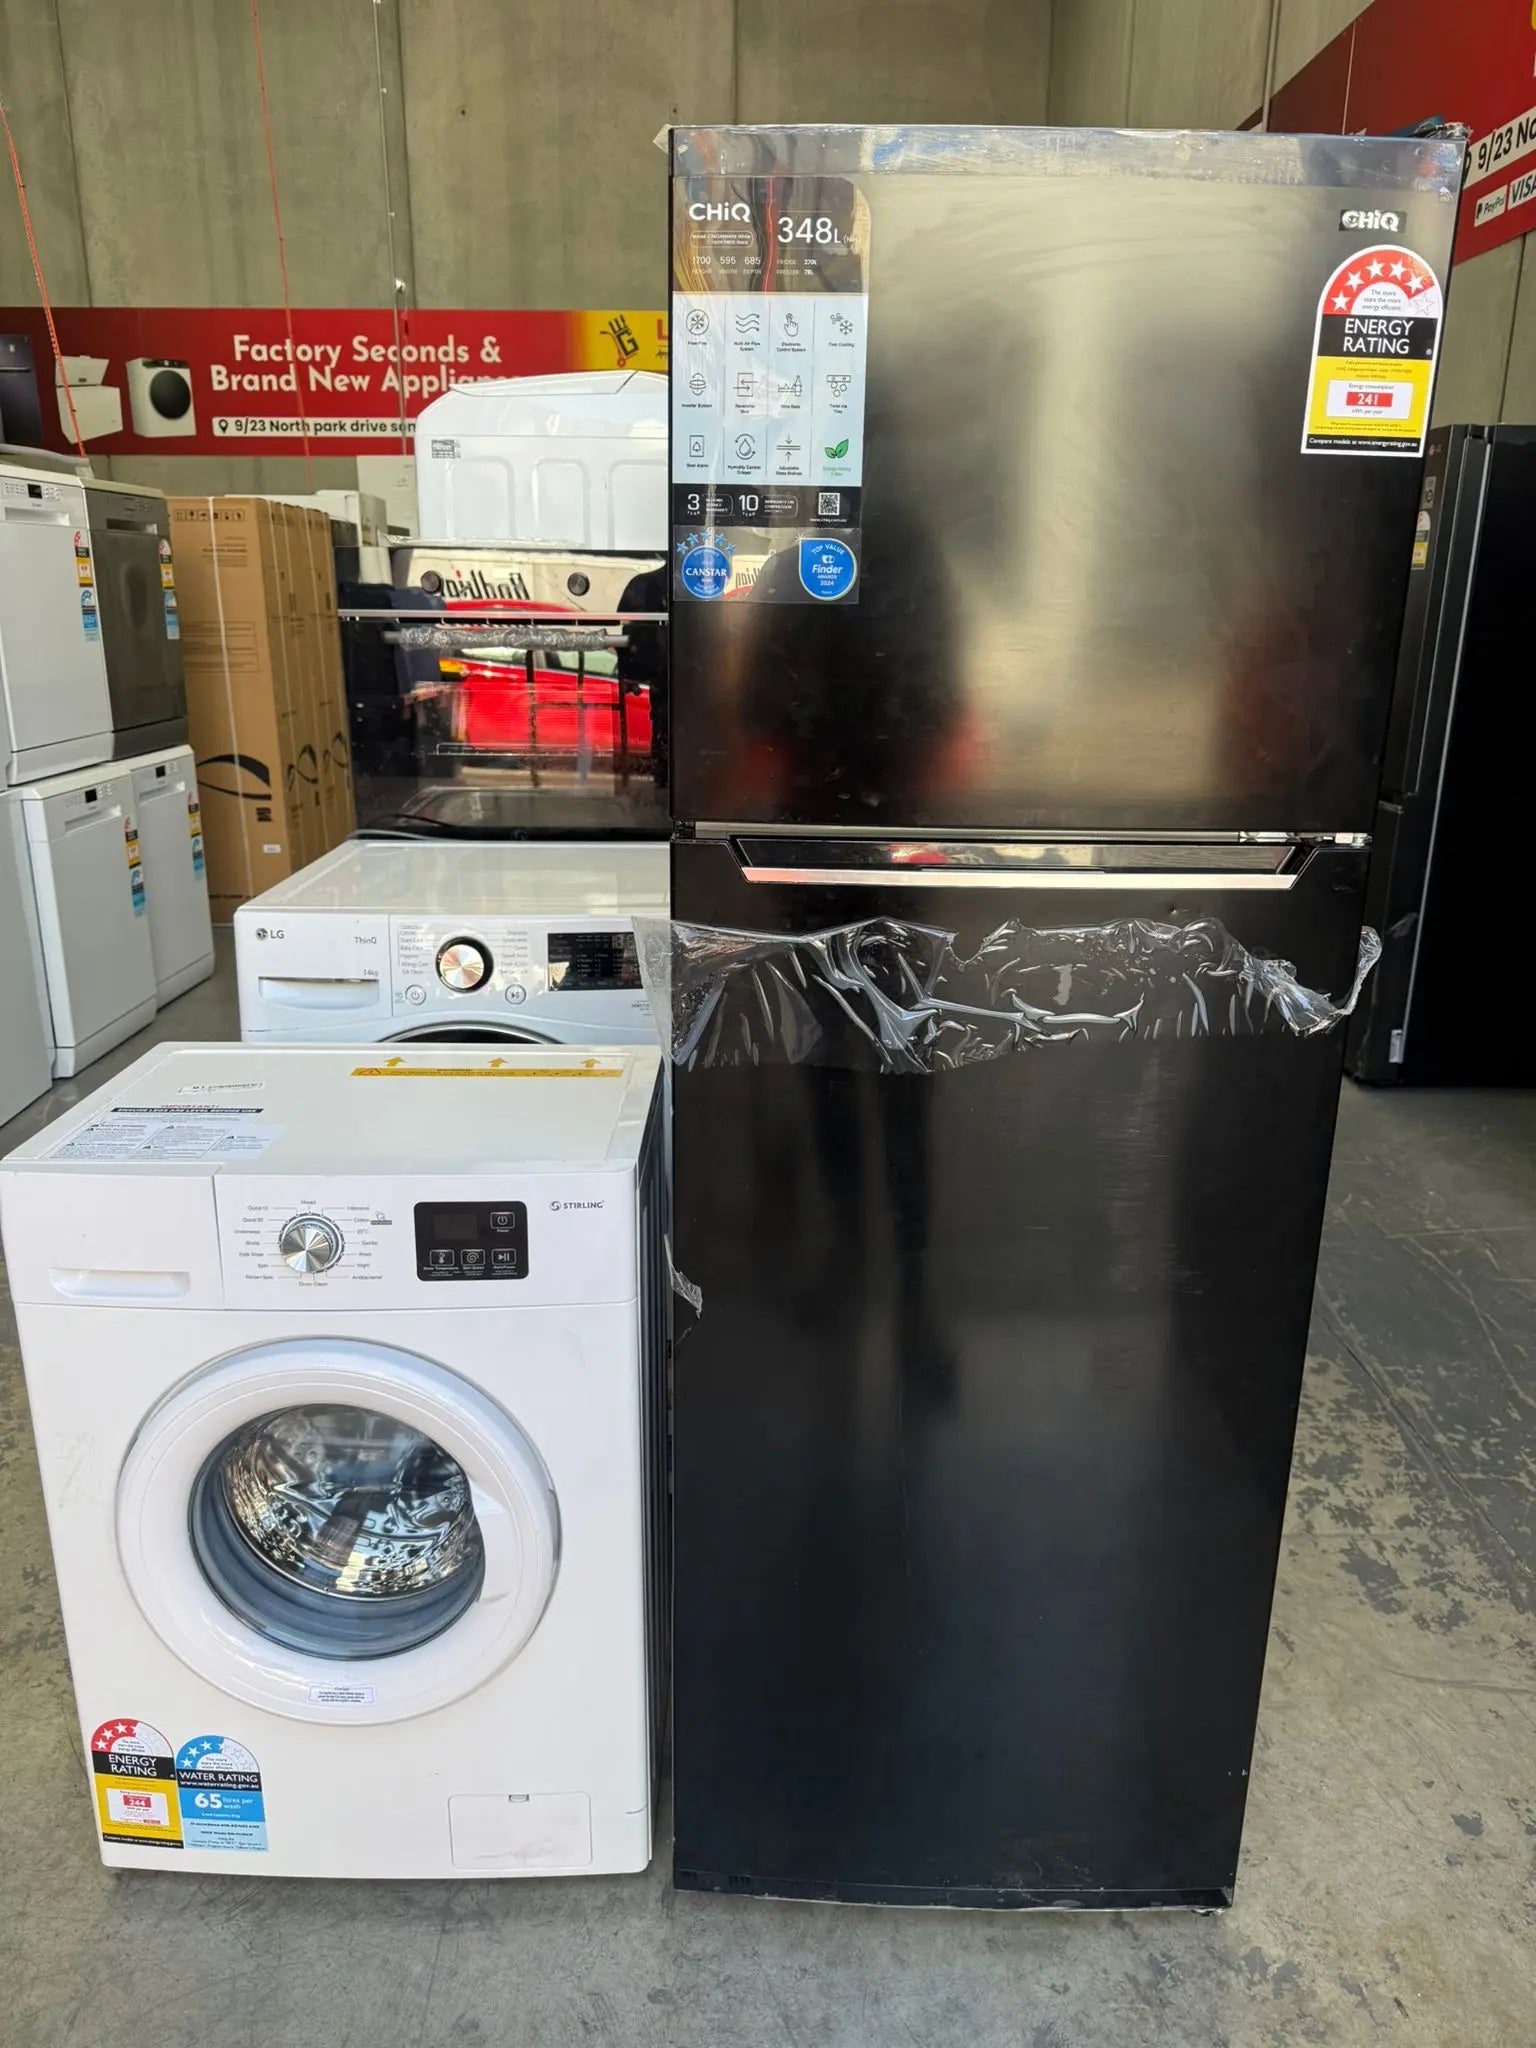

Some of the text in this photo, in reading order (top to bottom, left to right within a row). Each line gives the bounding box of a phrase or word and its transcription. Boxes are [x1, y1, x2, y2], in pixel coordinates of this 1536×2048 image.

[1478, 126, 1513, 172] 9/23
[689, 202, 751, 223] CHiQ
[1483, 196, 1504, 216] PayPal
[1341, 209, 1400, 232] CHiQ
[720, 256, 736, 265] 595
[744, 256, 761, 265] 685
[1345, 318, 1414, 336] ENERGY
[233, 334, 502, 369] Factory Seconds &
[1343, 336, 1410, 354] RATING
[210, 365, 297, 392] Brand
[309, 366, 371, 392] New
[1357, 393, 1379, 406] 241
[235, 418, 266, 434] 9/23
[270, 418, 310, 433] North
[314, 418, 347, 436] park
[350, 418, 387, 433] drive
[1309, 437, 1332, 445] Compare
[1358, 440, 1418, 448] www.energyrating.gov.au
[687, 493, 700, 511] 3
[739, 495, 759, 511] 10
[811, 544, 846, 555] TOP VALUE
[685, 567, 727, 577] CANSTAR
[811, 564, 844, 574] Finder
[270, 930, 285, 940] LG
[354, 936, 377, 944] ThinQ
[563, 1201, 603, 1210] STIRLING
[108, 1754, 157, 1767] ENERGY
[111, 1765, 157, 1777] RATING
[179, 1771, 258, 1783] WATER RATING
[180, 1781, 259, 1789] www.waterrating.gov.au
[194, 1793, 222, 1809] 65
